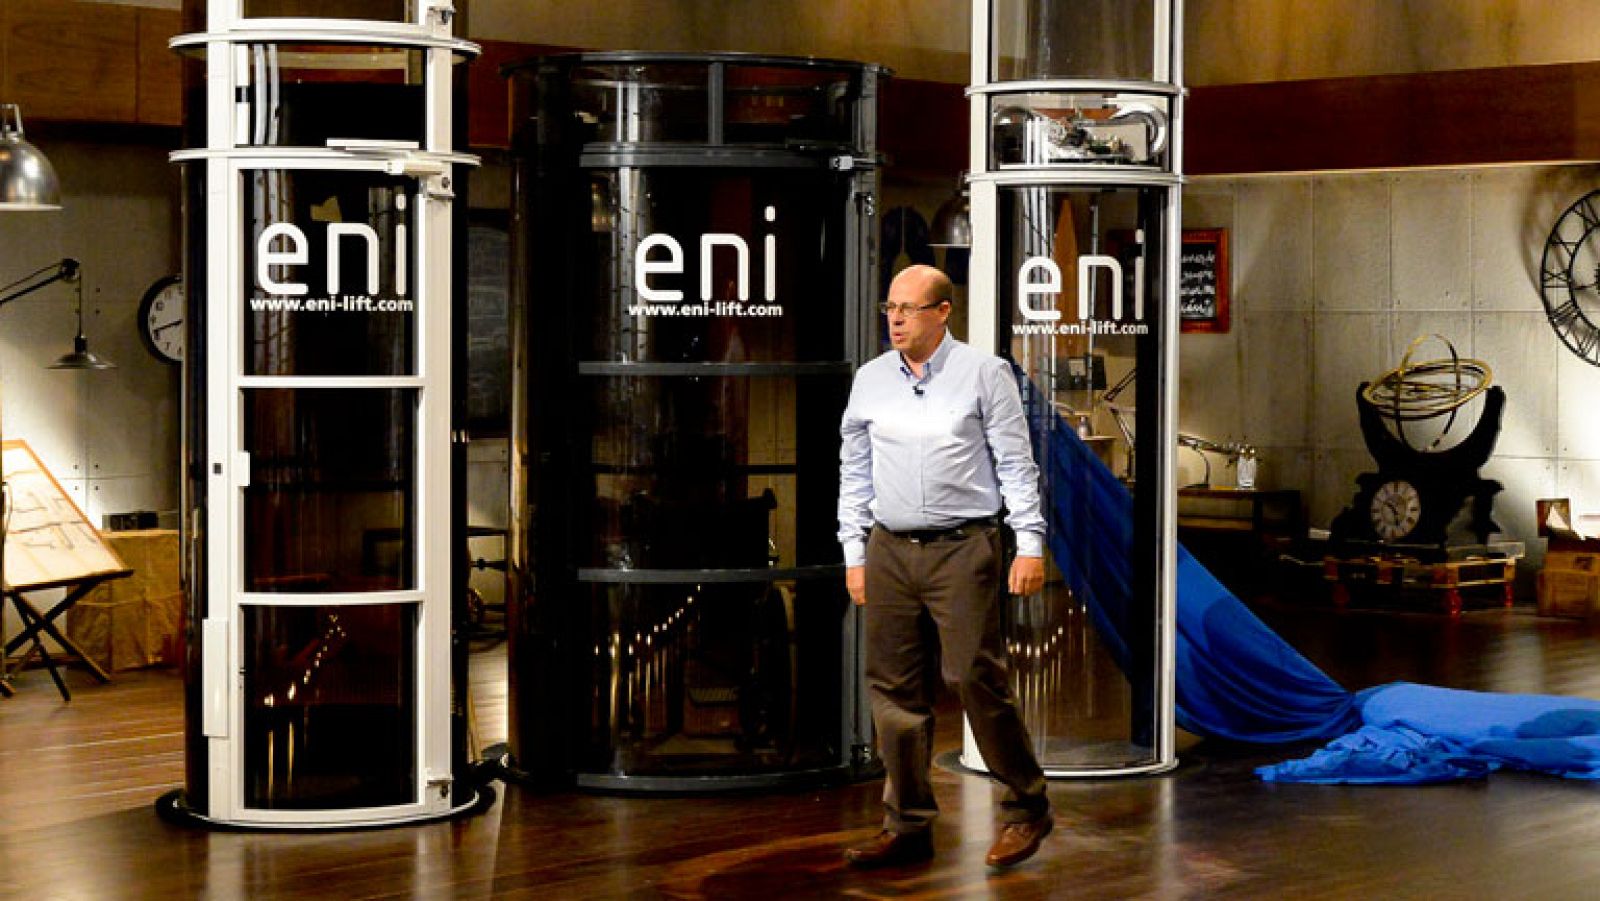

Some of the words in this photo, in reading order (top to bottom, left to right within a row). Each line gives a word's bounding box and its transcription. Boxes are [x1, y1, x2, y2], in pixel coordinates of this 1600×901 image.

[257, 194, 406, 295] eni
[635, 206, 776, 301] eni
[1018, 229, 1145, 320] eni
[251, 296, 413, 312] www.eni-lift.com
[628, 302, 783, 317] www.eni-lift.com
[1012, 321, 1149, 335] www.eni-lift.com
